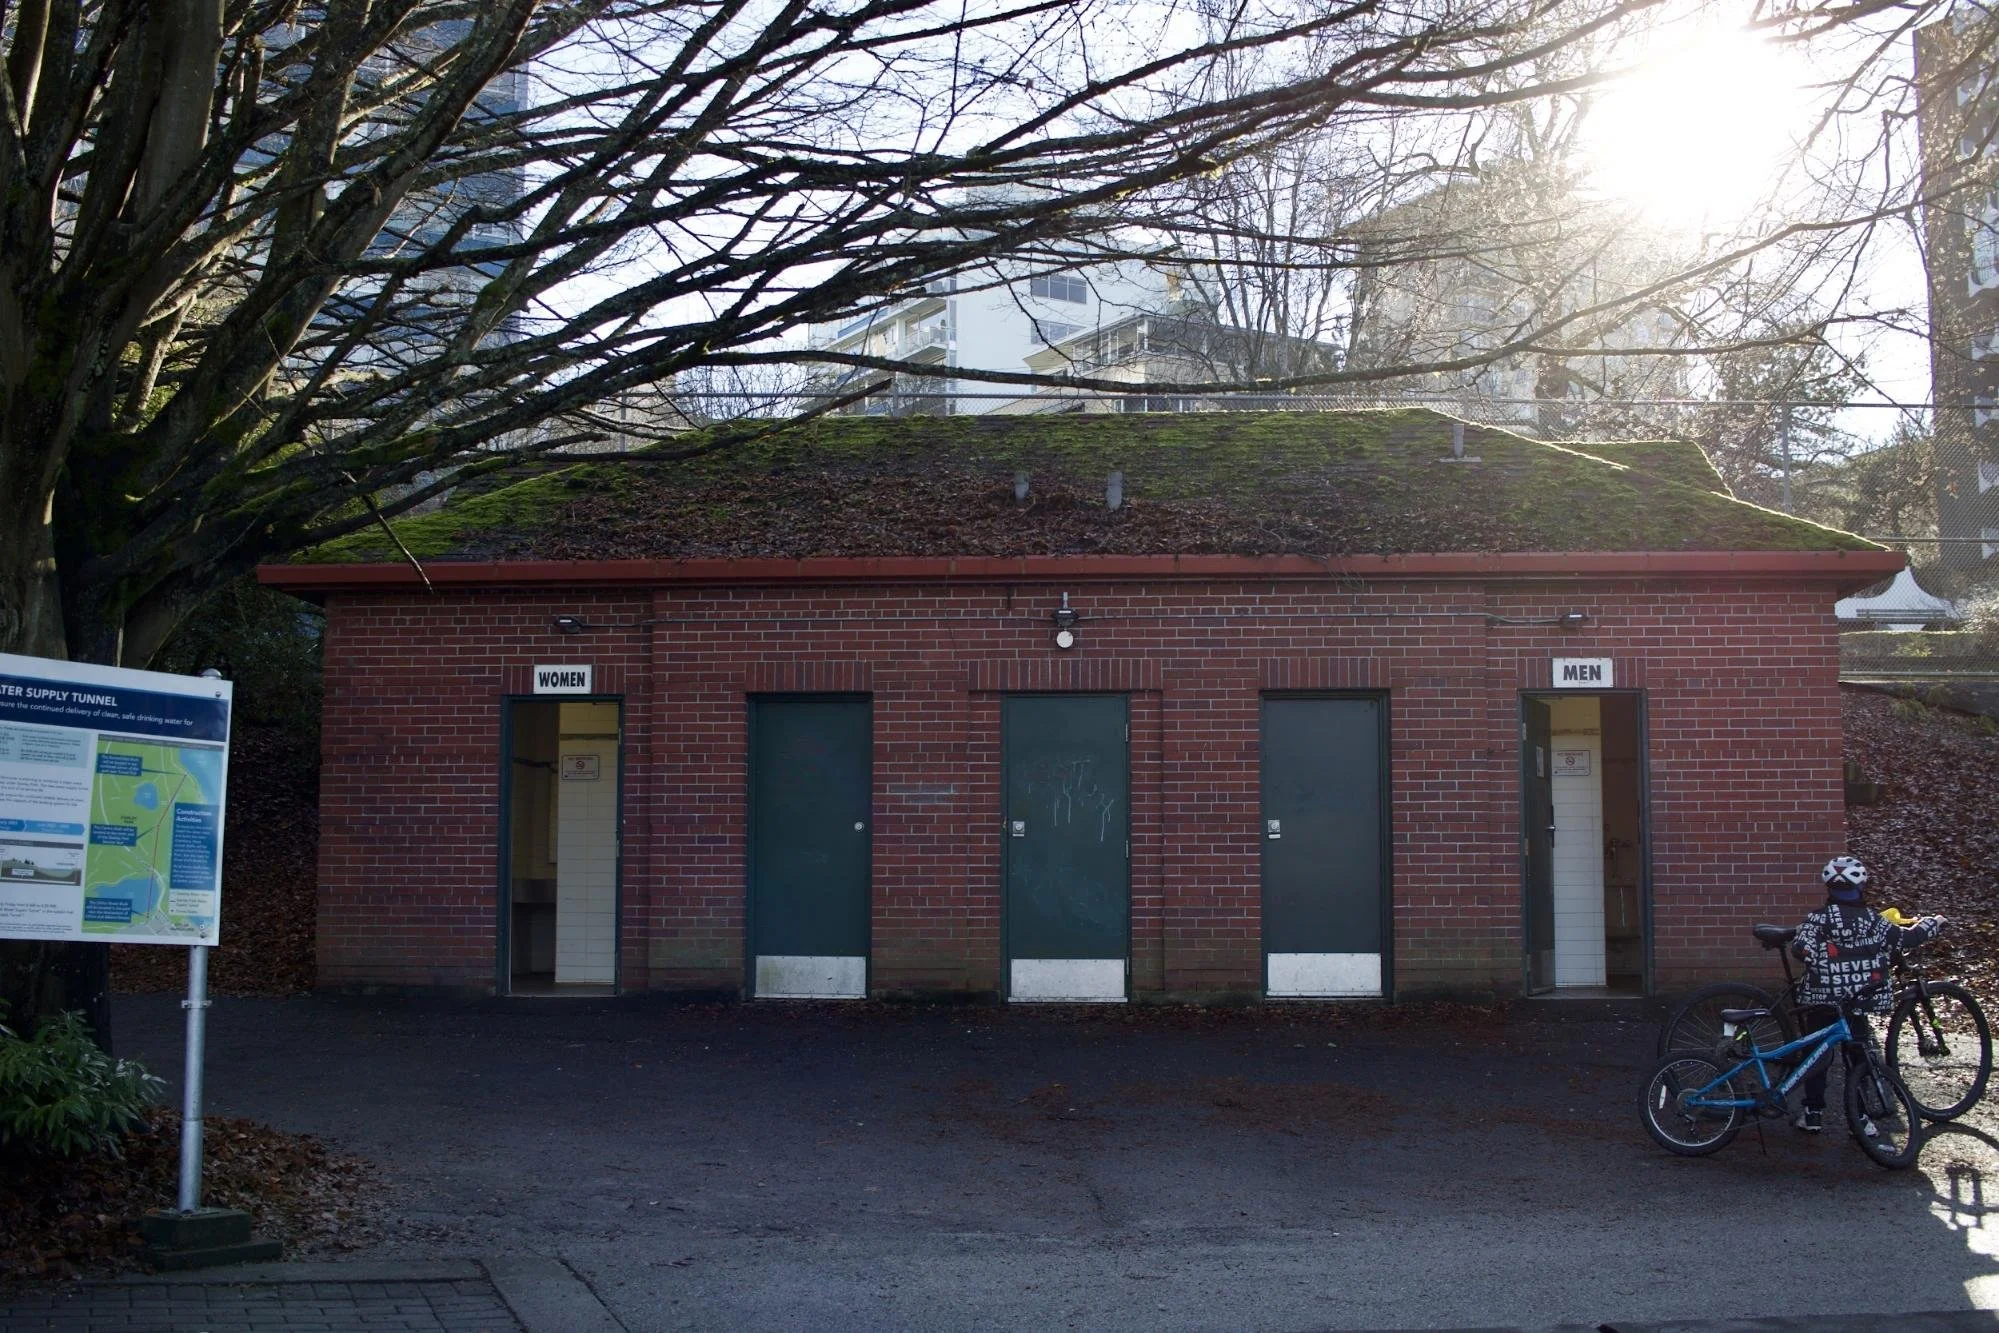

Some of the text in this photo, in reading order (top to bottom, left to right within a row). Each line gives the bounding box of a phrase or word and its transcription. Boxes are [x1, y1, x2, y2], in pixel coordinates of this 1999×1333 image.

[538, 671, 586, 688] WOMEN
[1563, 664, 1602, 681] MEN
[25, 687, 70, 701] SUPPLY
[71, 692, 118, 707] TUNNEL
[17, 701, 29, 709] the
[30, 703, 65, 713] continued
[65, 707, 92, 717] delivery
[92, 709, 101, 717] of
[121, 712, 136, 721] safe
[136, 714, 163, 725] drinking
[164, 717, 183, 725] water
[183, 718, 194, 726] for
[1818, 942, 1830, 985] NEVER
[1830, 959, 1881, 974] NEVER
[1832, 971, 1872, 985] STOP
